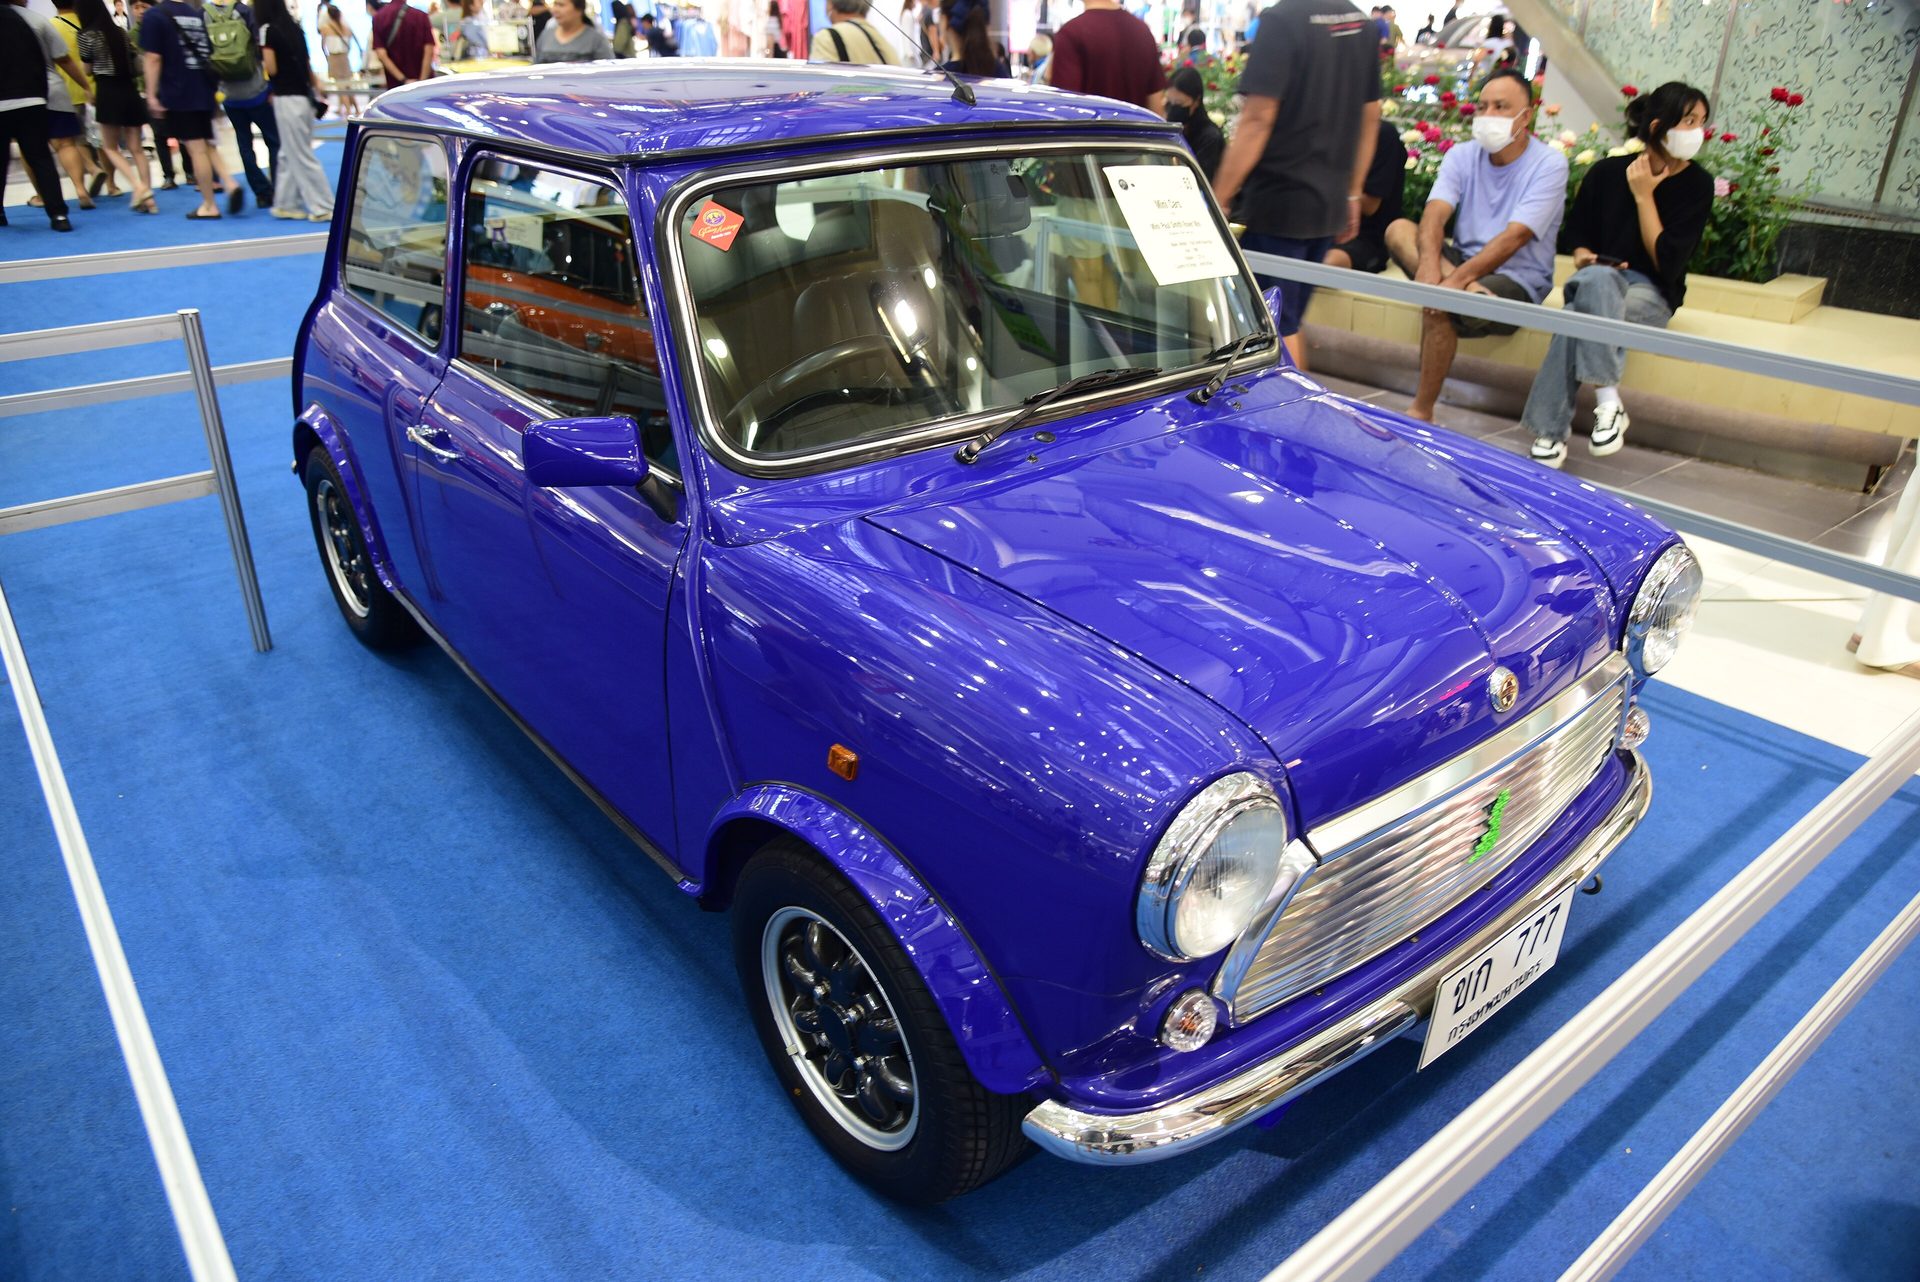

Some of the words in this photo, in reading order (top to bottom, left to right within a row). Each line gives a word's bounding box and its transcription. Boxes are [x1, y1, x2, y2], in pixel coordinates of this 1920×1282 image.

[1512, 902, 1561, 969] 777
[1447, 958, 1543, 1043] กรุงเทพมหานคร
